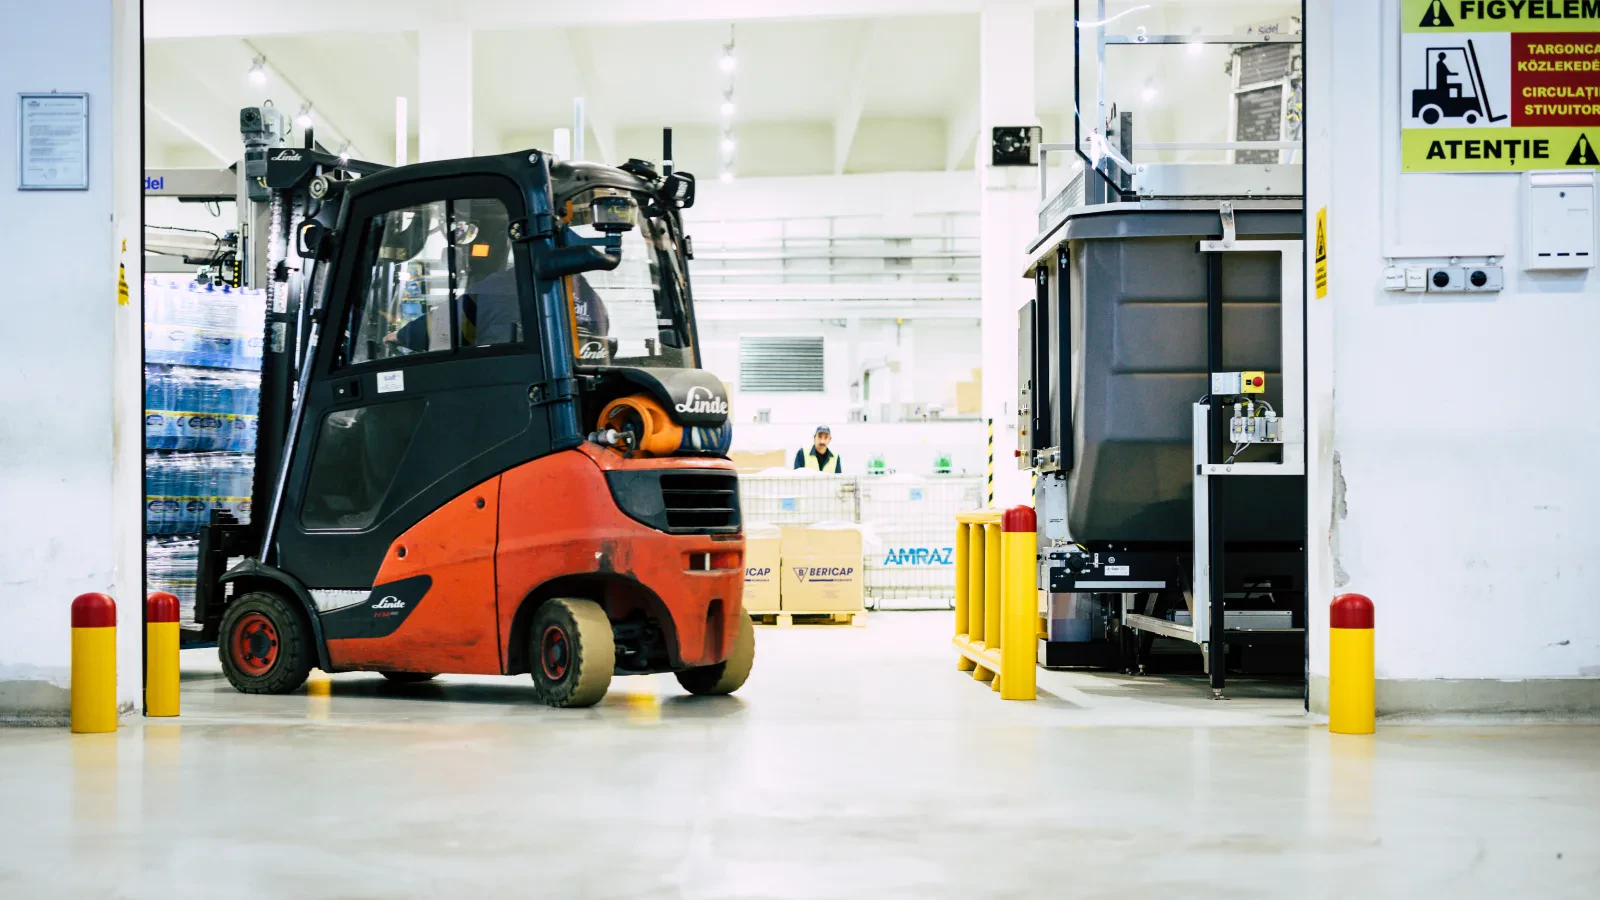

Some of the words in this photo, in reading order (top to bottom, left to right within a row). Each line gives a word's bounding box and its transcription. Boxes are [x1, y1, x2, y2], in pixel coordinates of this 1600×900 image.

[1460, 0, 1600, 19] FIGYELEM
[1527, 44, 1600, 55] TARGONCA
[1517, 59, 1600, 71] KÖZLEKEDÉ
[1522, 86, 1600, 100] CIRCULAȚI
[1524, 104, 1600, 115] STIVUITOR
[270, 149, 302, 161] Linde
[1426, 139, 1549, 165] ATENȚIE
[675, 386, 728, 414] Linde
[883, 547, 953, 566] AMRAZ
[809, 567, 854, 576] BERICAP
[371, 595, 406, 609] Linde
